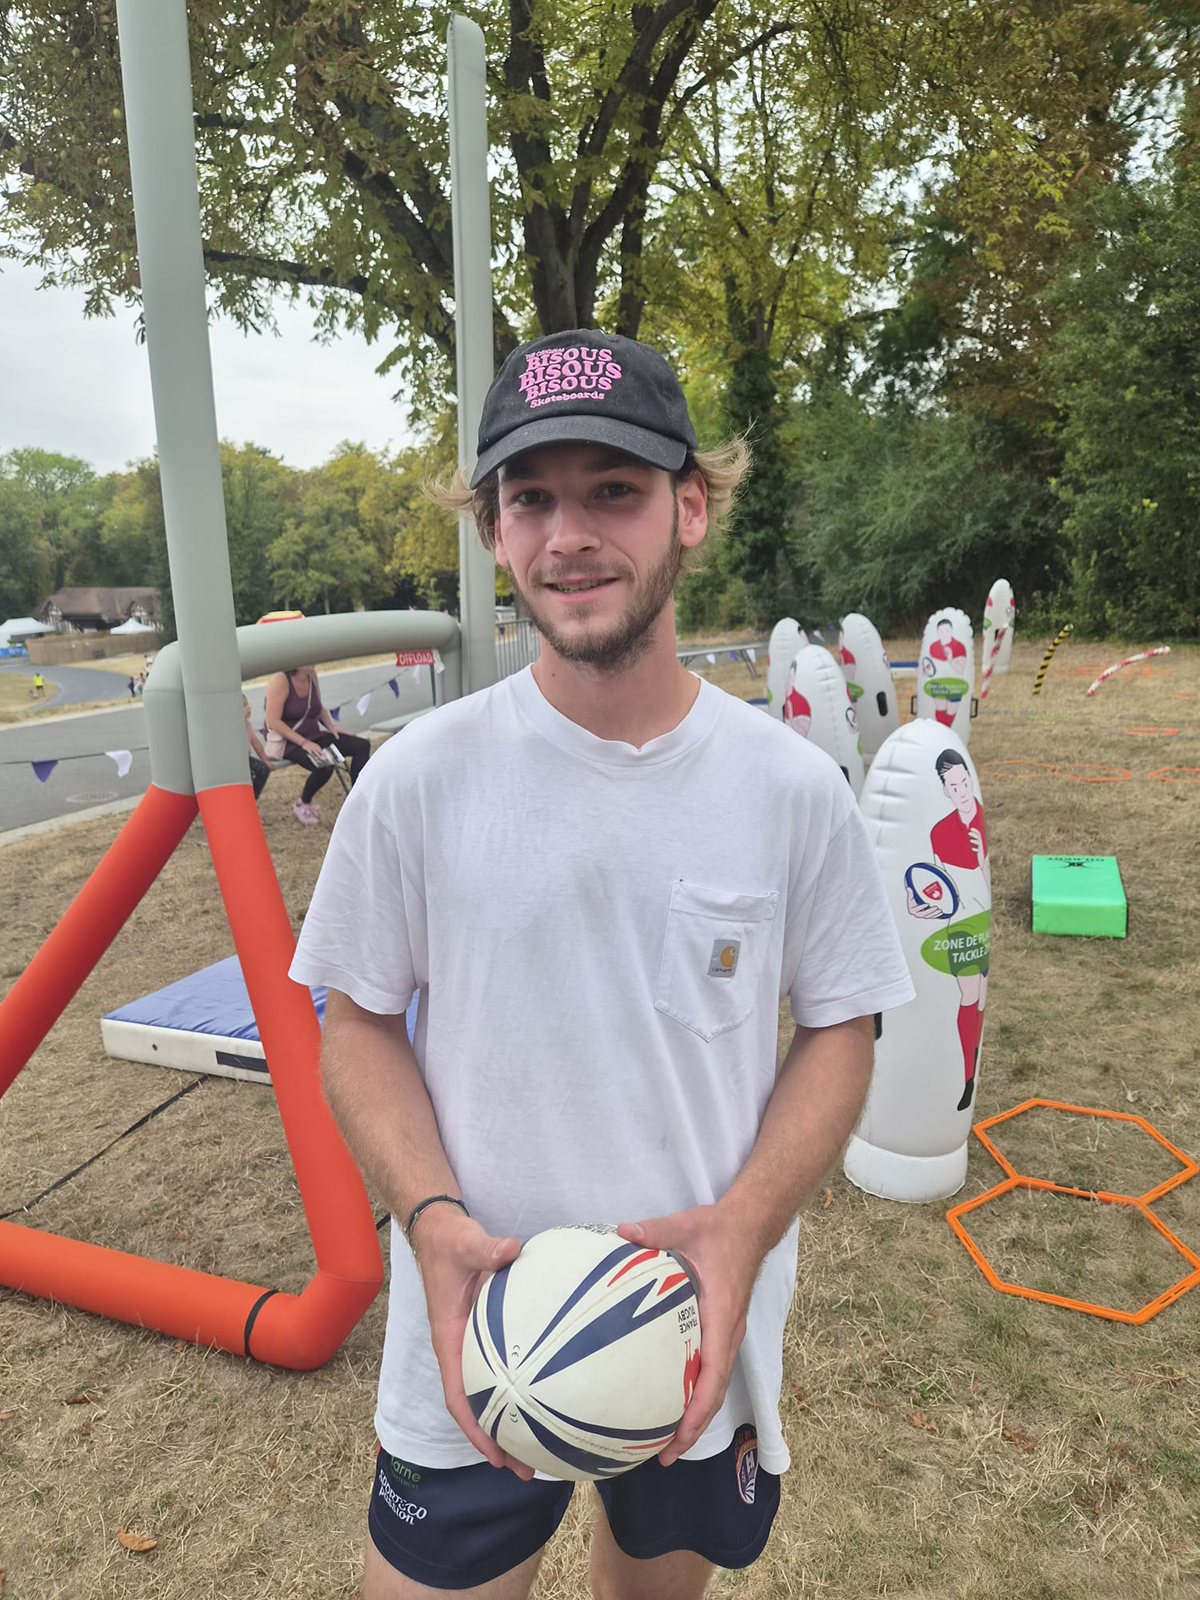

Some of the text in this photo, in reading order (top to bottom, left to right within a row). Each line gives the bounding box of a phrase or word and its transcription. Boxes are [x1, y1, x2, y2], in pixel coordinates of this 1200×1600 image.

[526, 347, 613, 372] BISOUS
[519, 360, 622, 392] BISOUS
[525, 376, 612, 402] BISOUS
[530, 391, 605, 408] Skateboards
[399, 652, 434, 665] OFFLOAD
[934, 937, 965, 951] ZONE
[966, 934, 978, 947] DE
[952, 946, 984, 963] TACKLE
